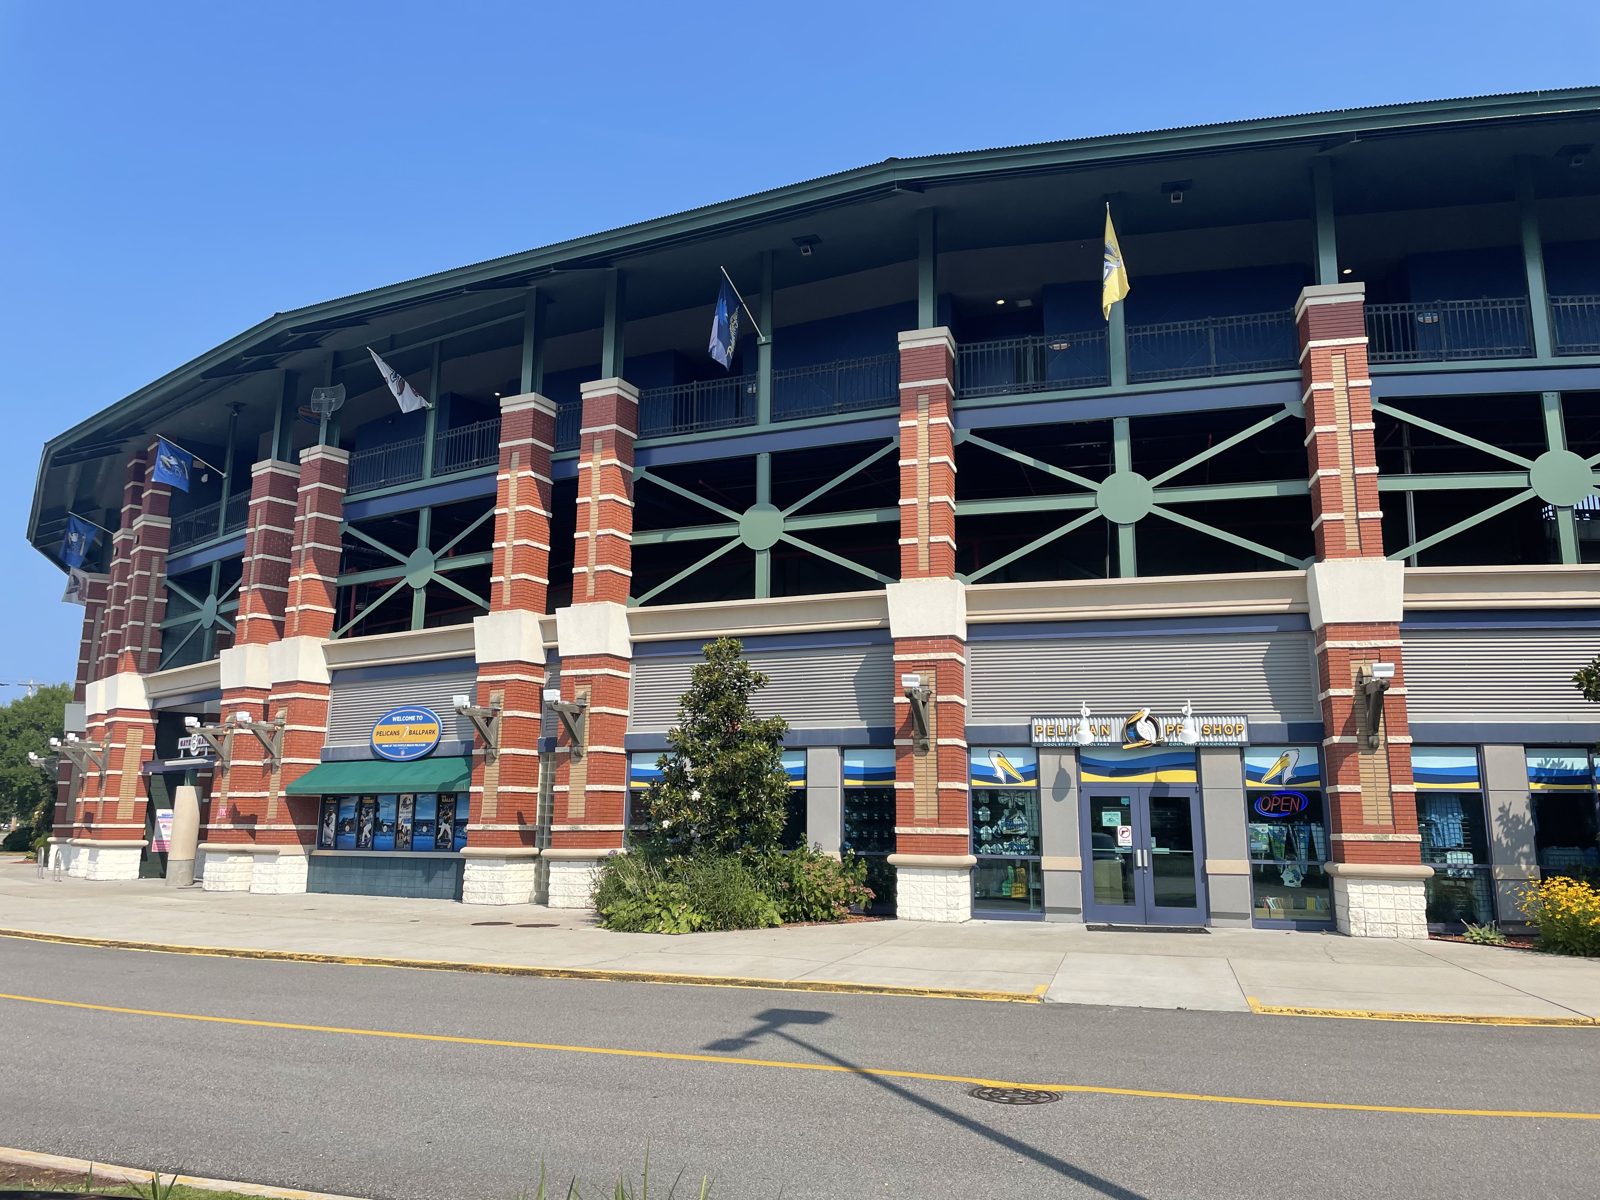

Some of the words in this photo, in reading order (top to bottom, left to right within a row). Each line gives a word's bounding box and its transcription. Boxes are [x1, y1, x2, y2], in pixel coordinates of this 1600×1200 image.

[1165, 724, 1189, 736] PR
[1202, 724, 1244, 736] SHOP
[1260, 796, 1301, 812] OPEN
